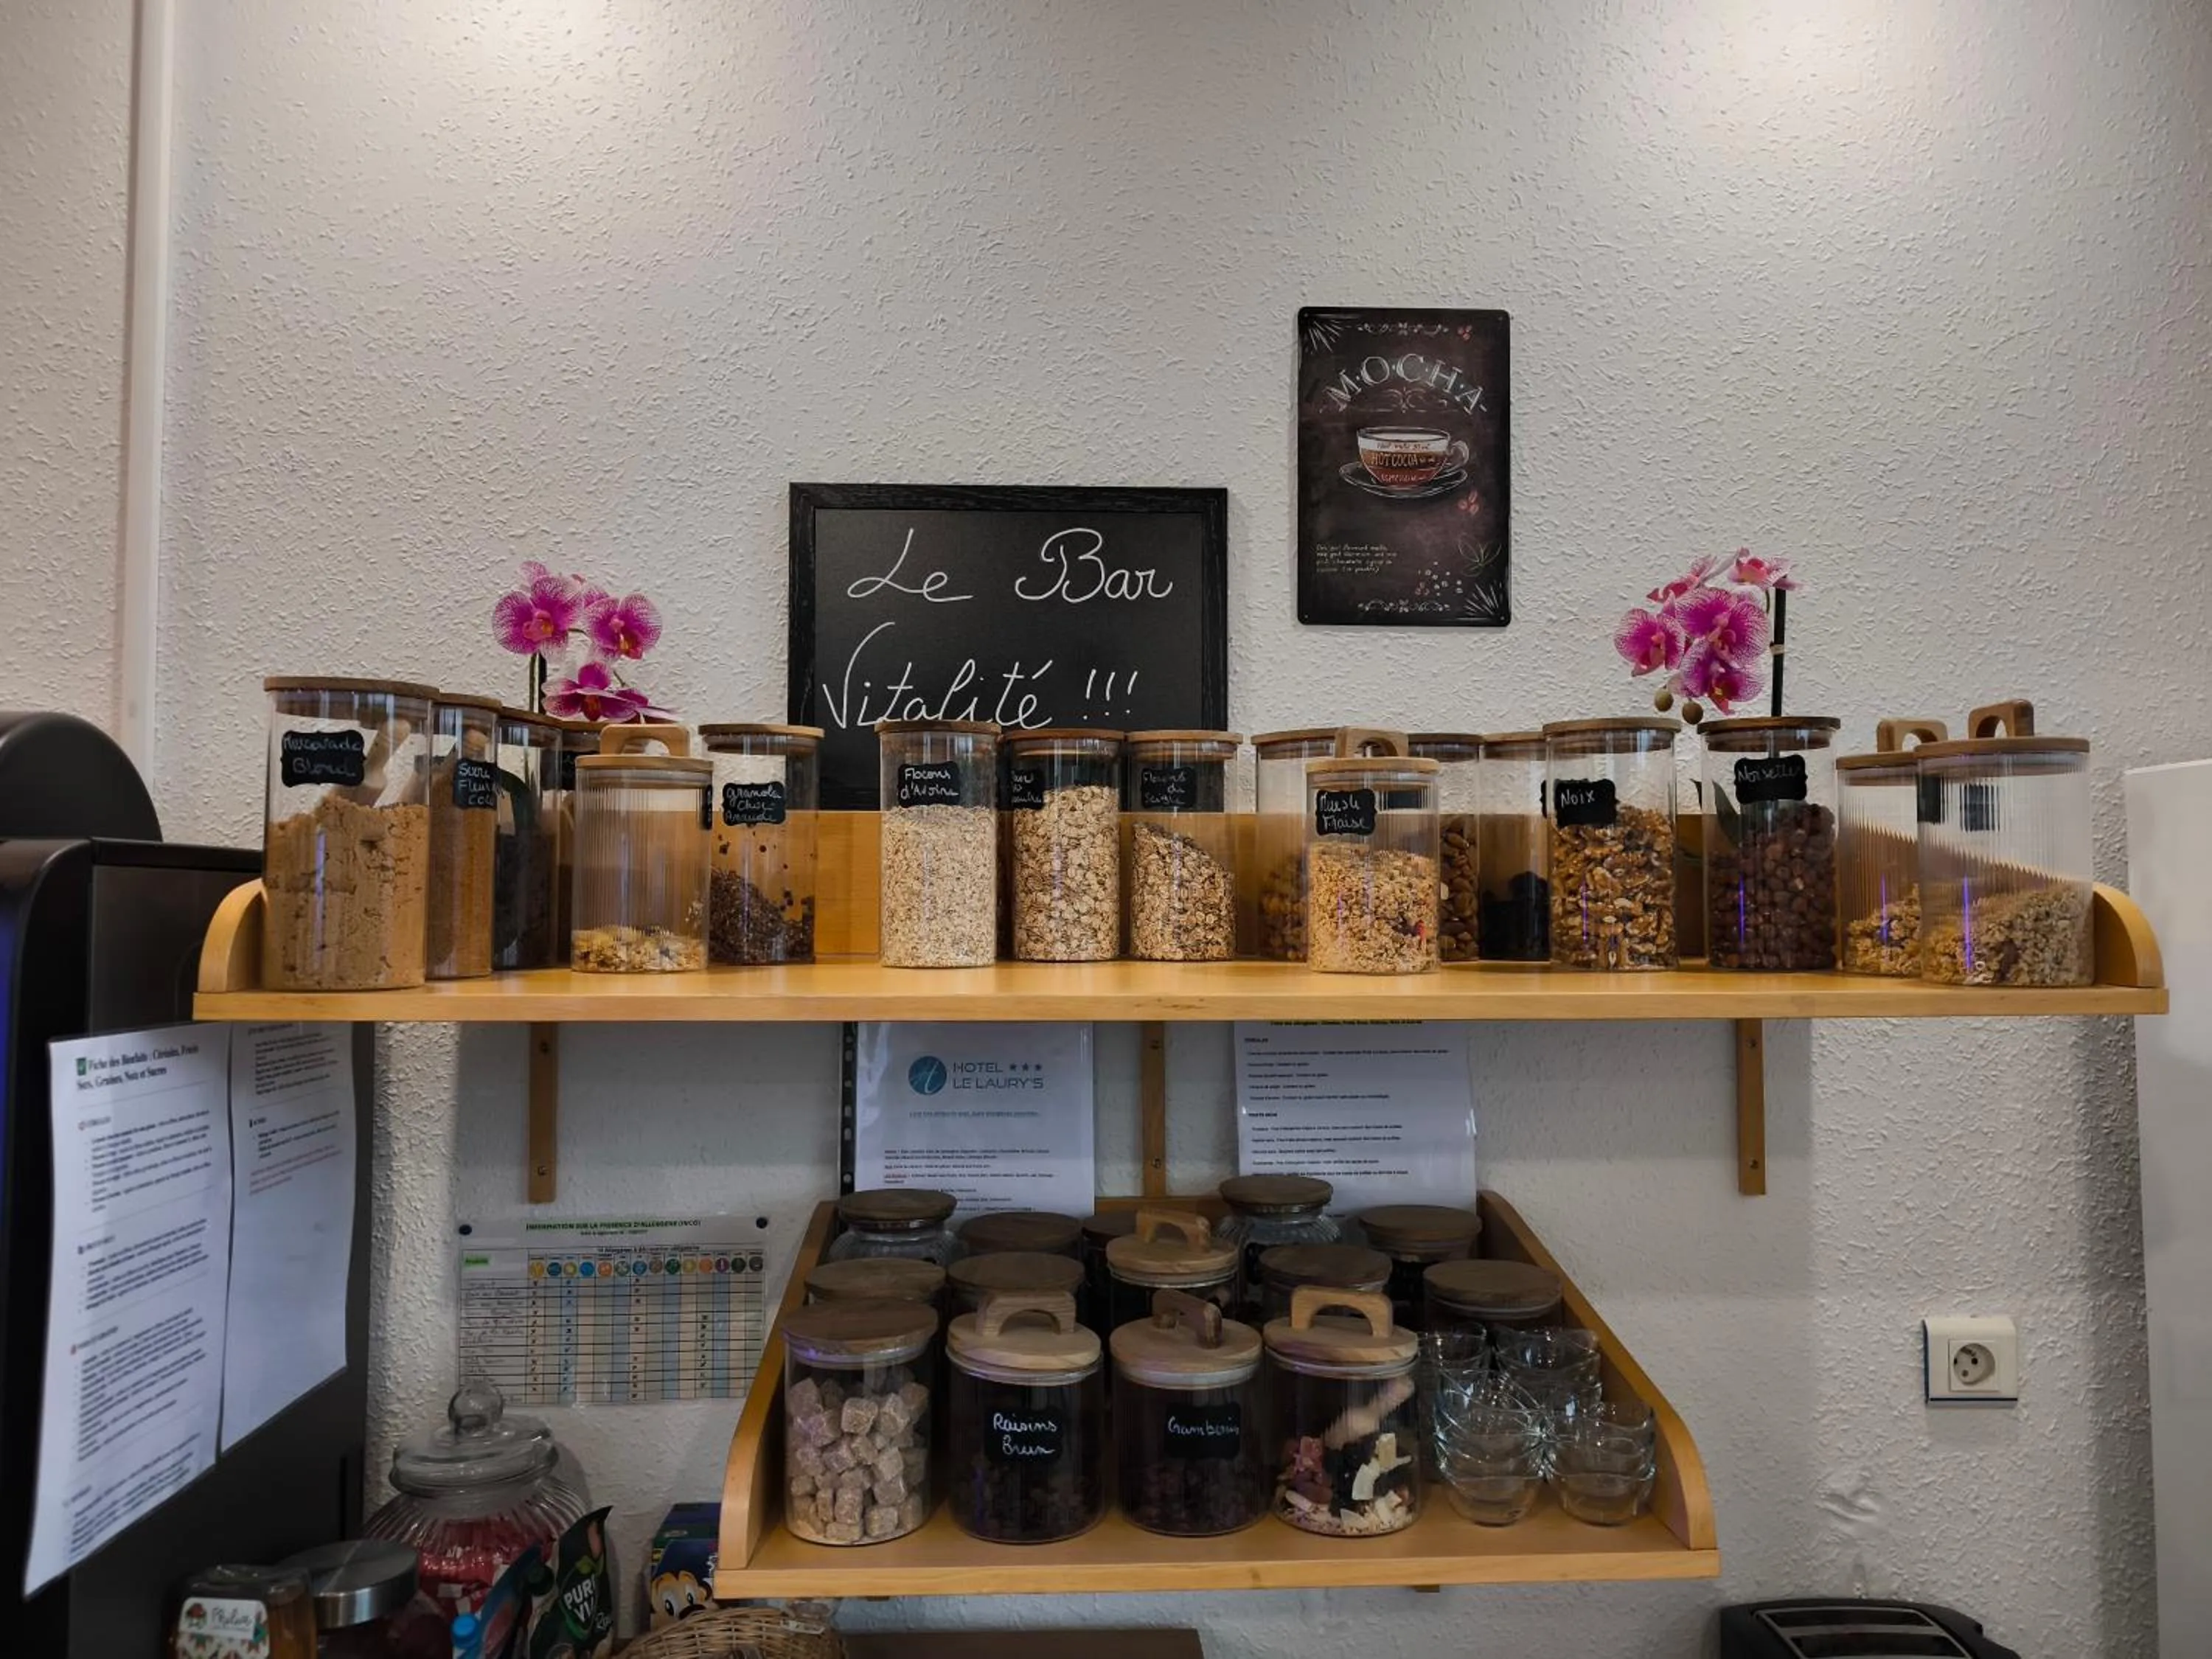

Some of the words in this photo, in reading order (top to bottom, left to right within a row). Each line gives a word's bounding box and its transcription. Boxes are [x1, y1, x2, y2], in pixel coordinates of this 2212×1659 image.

[846, 527, 974, 602] Le
[1014, 526, 1174, 604] Bar
[822, 621, 1054, 730] Vitalité
[953, 1062, 1004, 1074] HOTEL
[953, 1077, 973, 1090] LE
[975, 1077, 1044, 1090] LAURY'S
[992, 1412, 1057, 1433] Raisins
